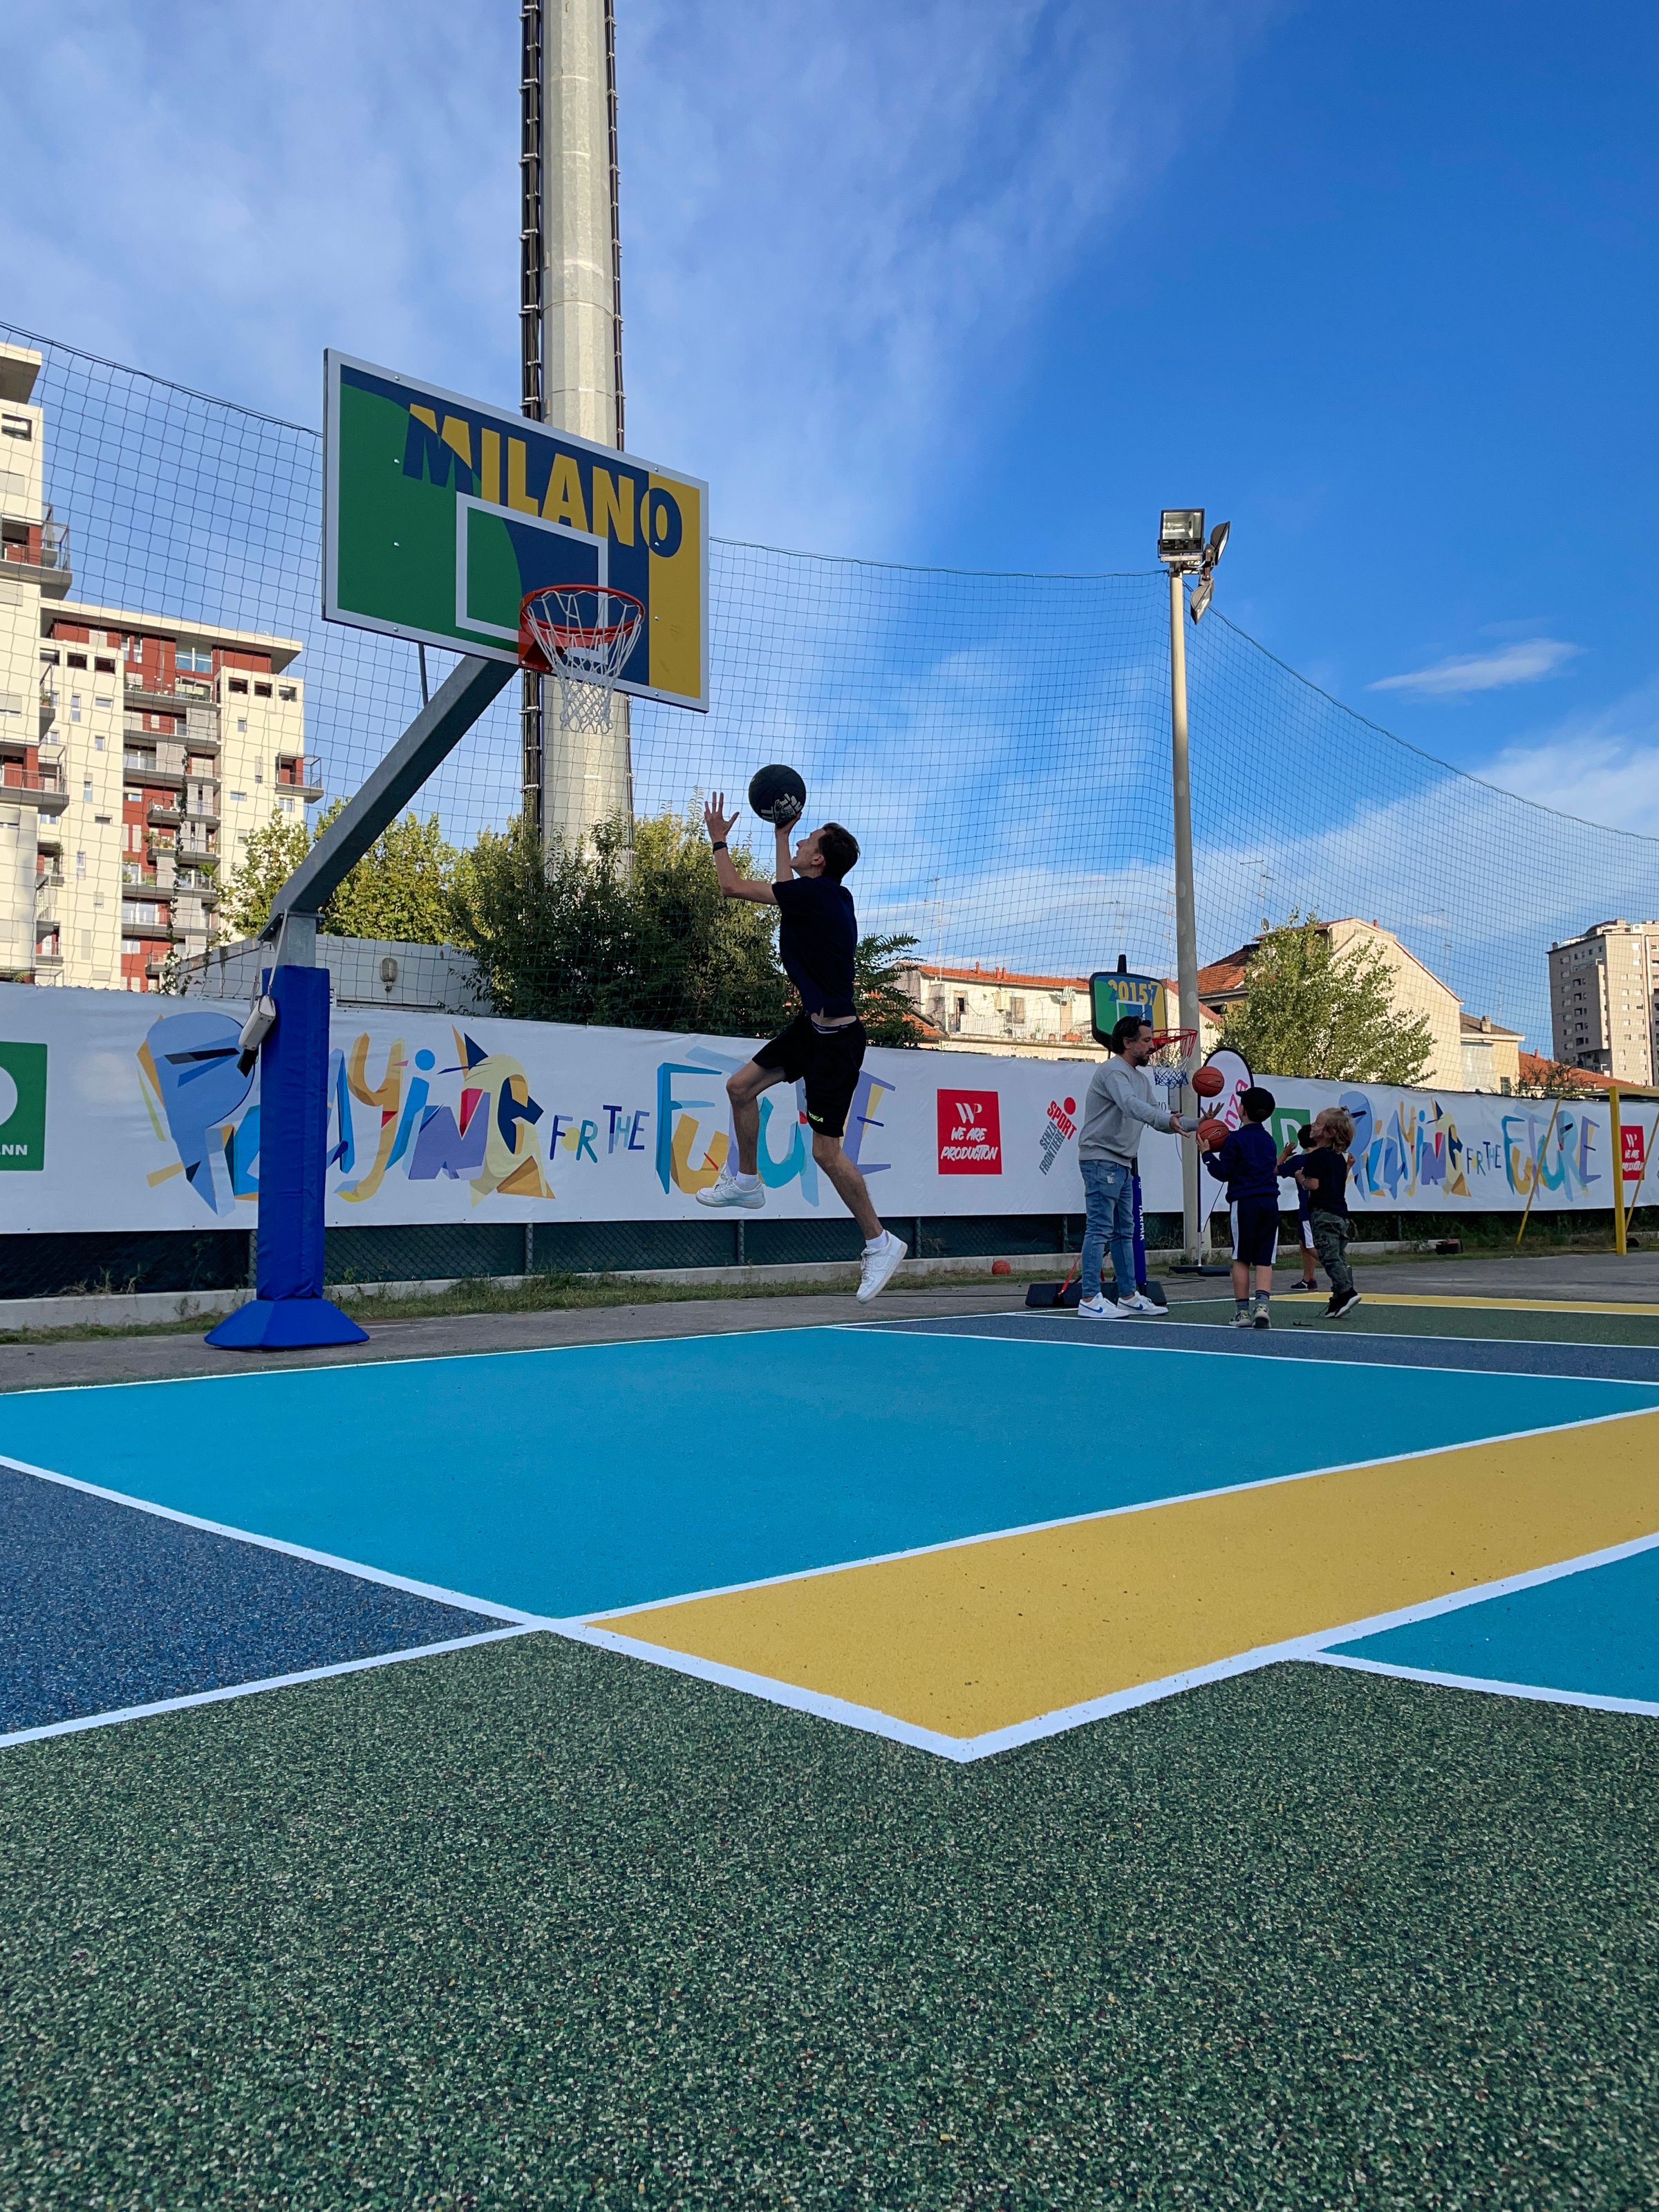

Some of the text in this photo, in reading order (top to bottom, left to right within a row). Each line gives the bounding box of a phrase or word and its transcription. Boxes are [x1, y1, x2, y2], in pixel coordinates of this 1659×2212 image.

[402, 403, 682, 558] MILANO
[1107, 979, 1158, 1006] 20157
[550, 1115, 598, 1163] FOR
[603, 1105, 650, 1154] THE
[950, 1127, 988, 1143] WE ARE
[1039, 1121, 1058, 1151] SENZA
[1046, 1100, 1078, 1141] SPORT
[940, 1144, 999, 1161] PRODUCTION
[1038, 1129, 1066, 1176] FRONTIERE
[1466, 1147, 1485, 1176] FOR
[1483, 1141, 1501, 1170] THE
[1501, 1106, 1602, 1202] FUTURE
